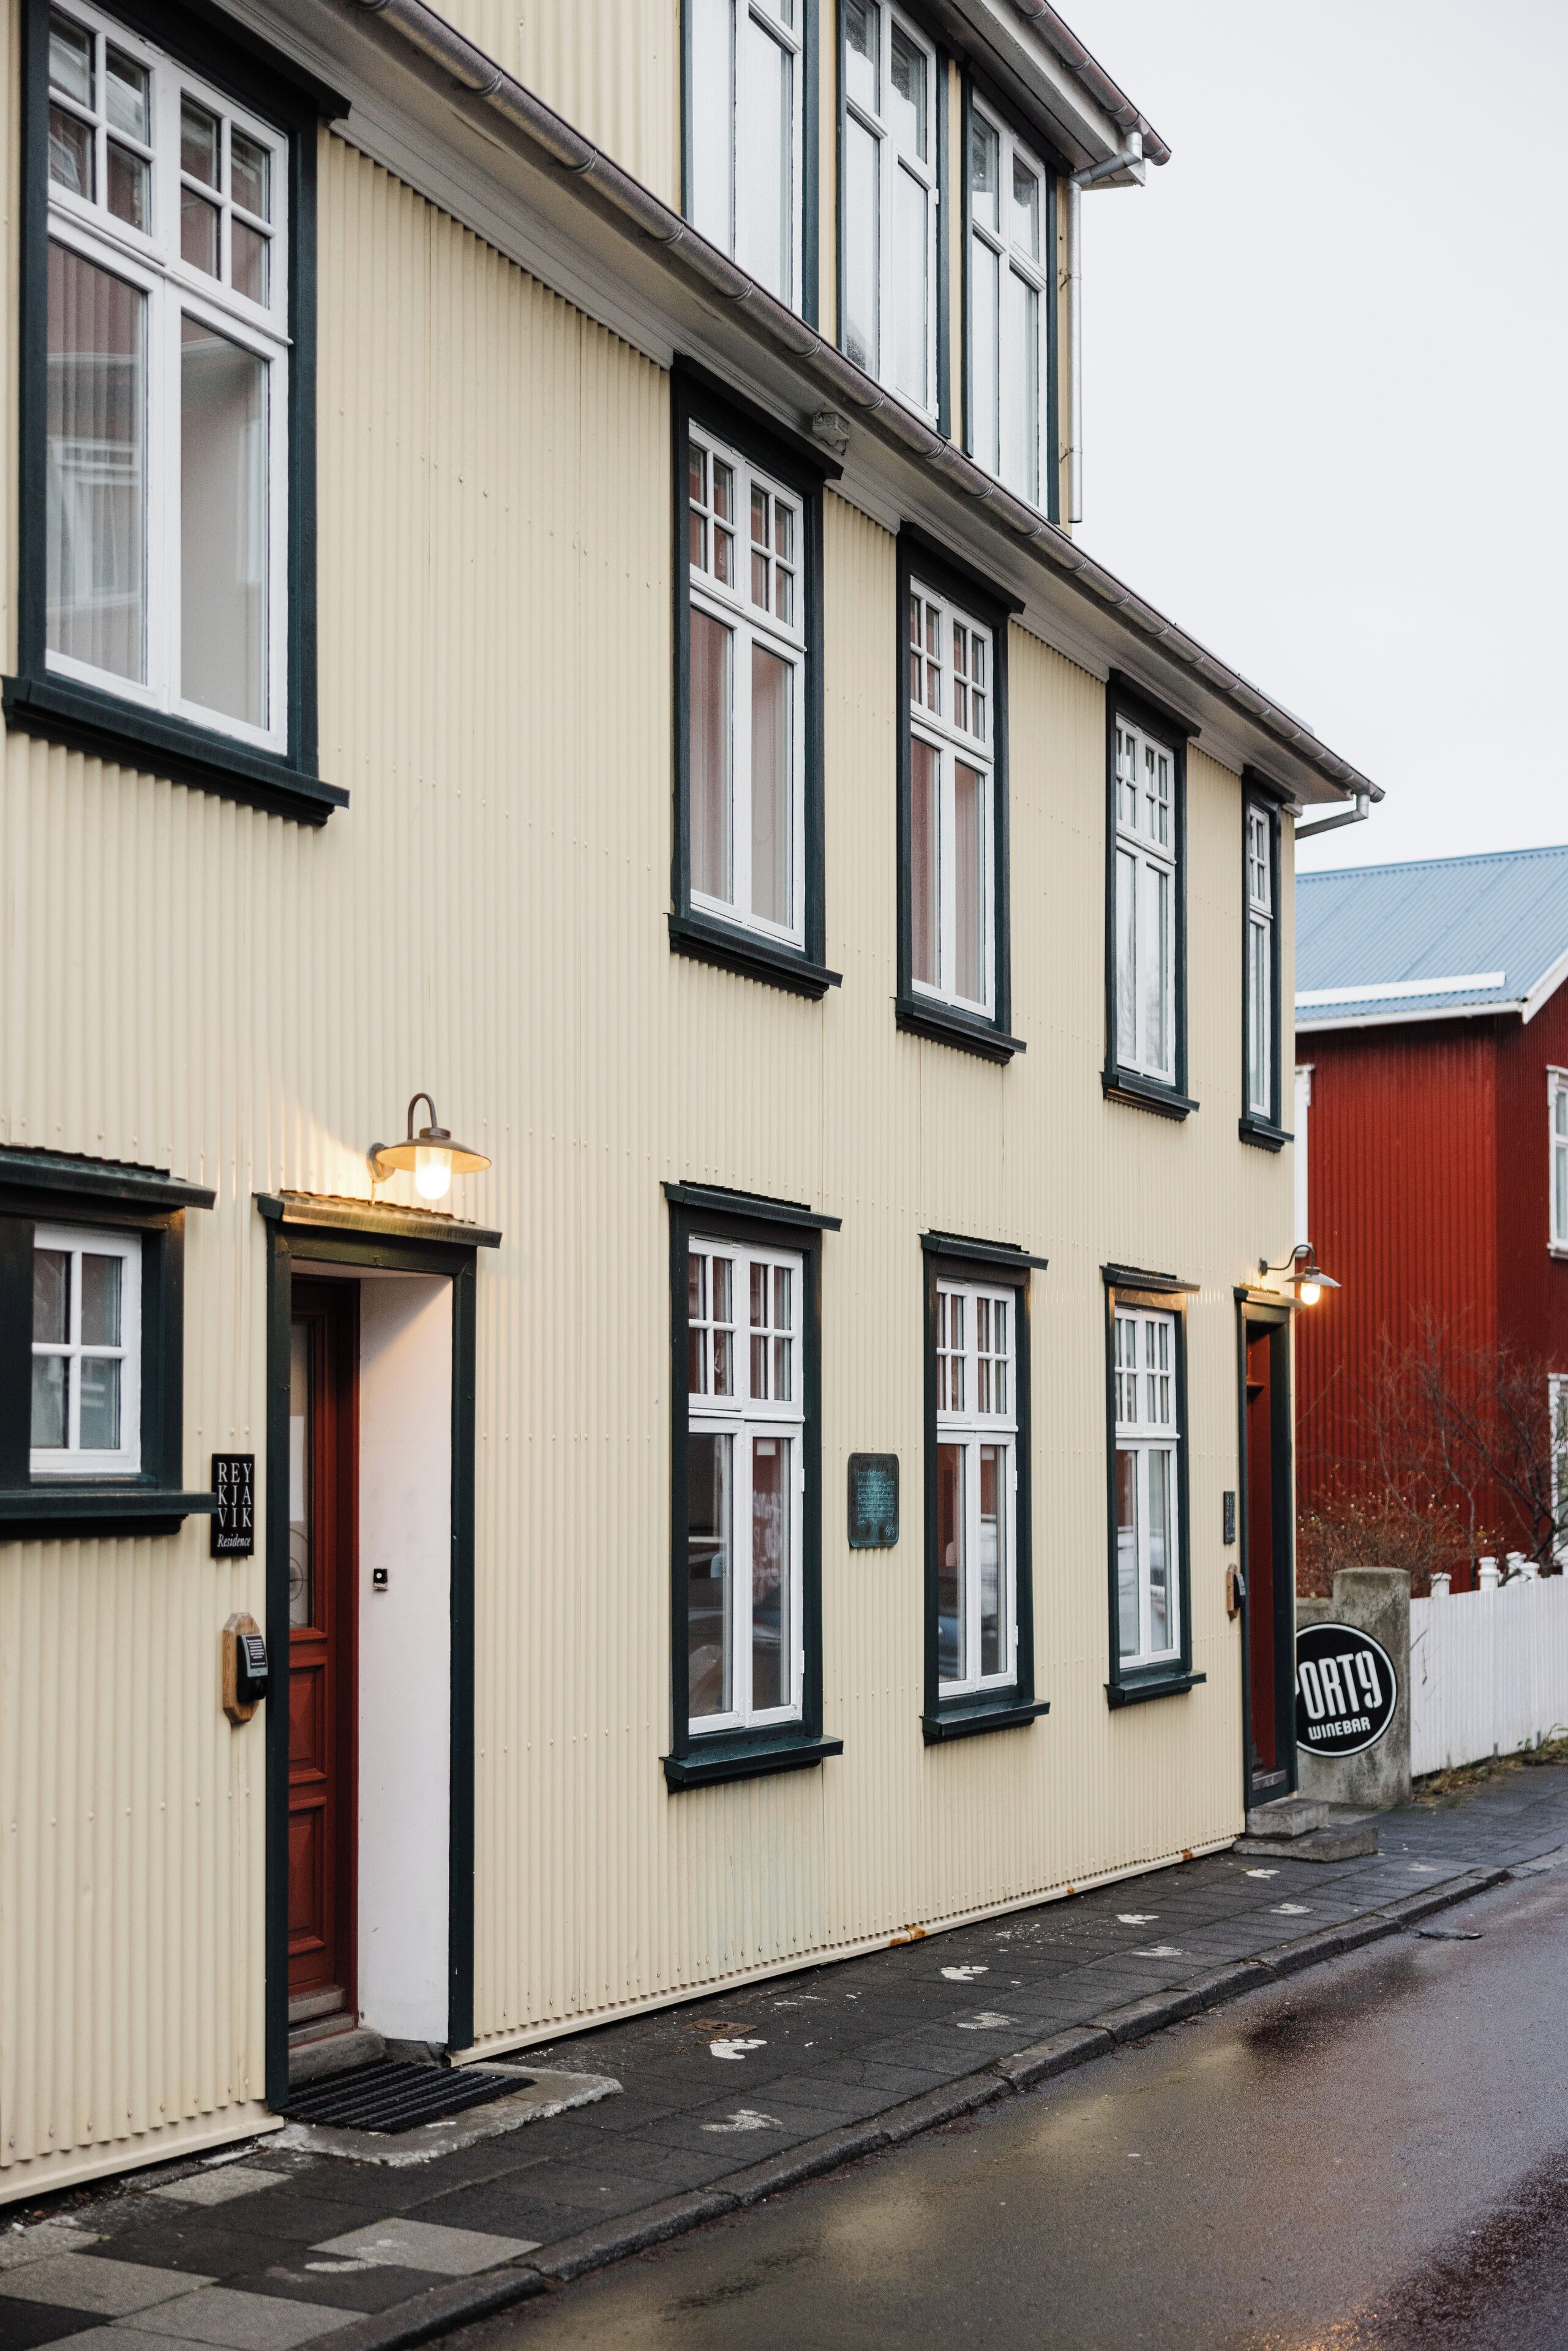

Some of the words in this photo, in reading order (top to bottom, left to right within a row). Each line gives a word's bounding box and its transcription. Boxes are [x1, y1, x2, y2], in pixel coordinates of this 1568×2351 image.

[218, 1462, 252, 1482] REY
[218, 1485, 252, 1506] KJA
[218, 1507, 252, 1528] VIK
[217, 1533, 251, 1547] Residence
[1296, 1651, 1382, 1720] ORT9
[1308, 1716, 1371, 1741] WINEBAR
